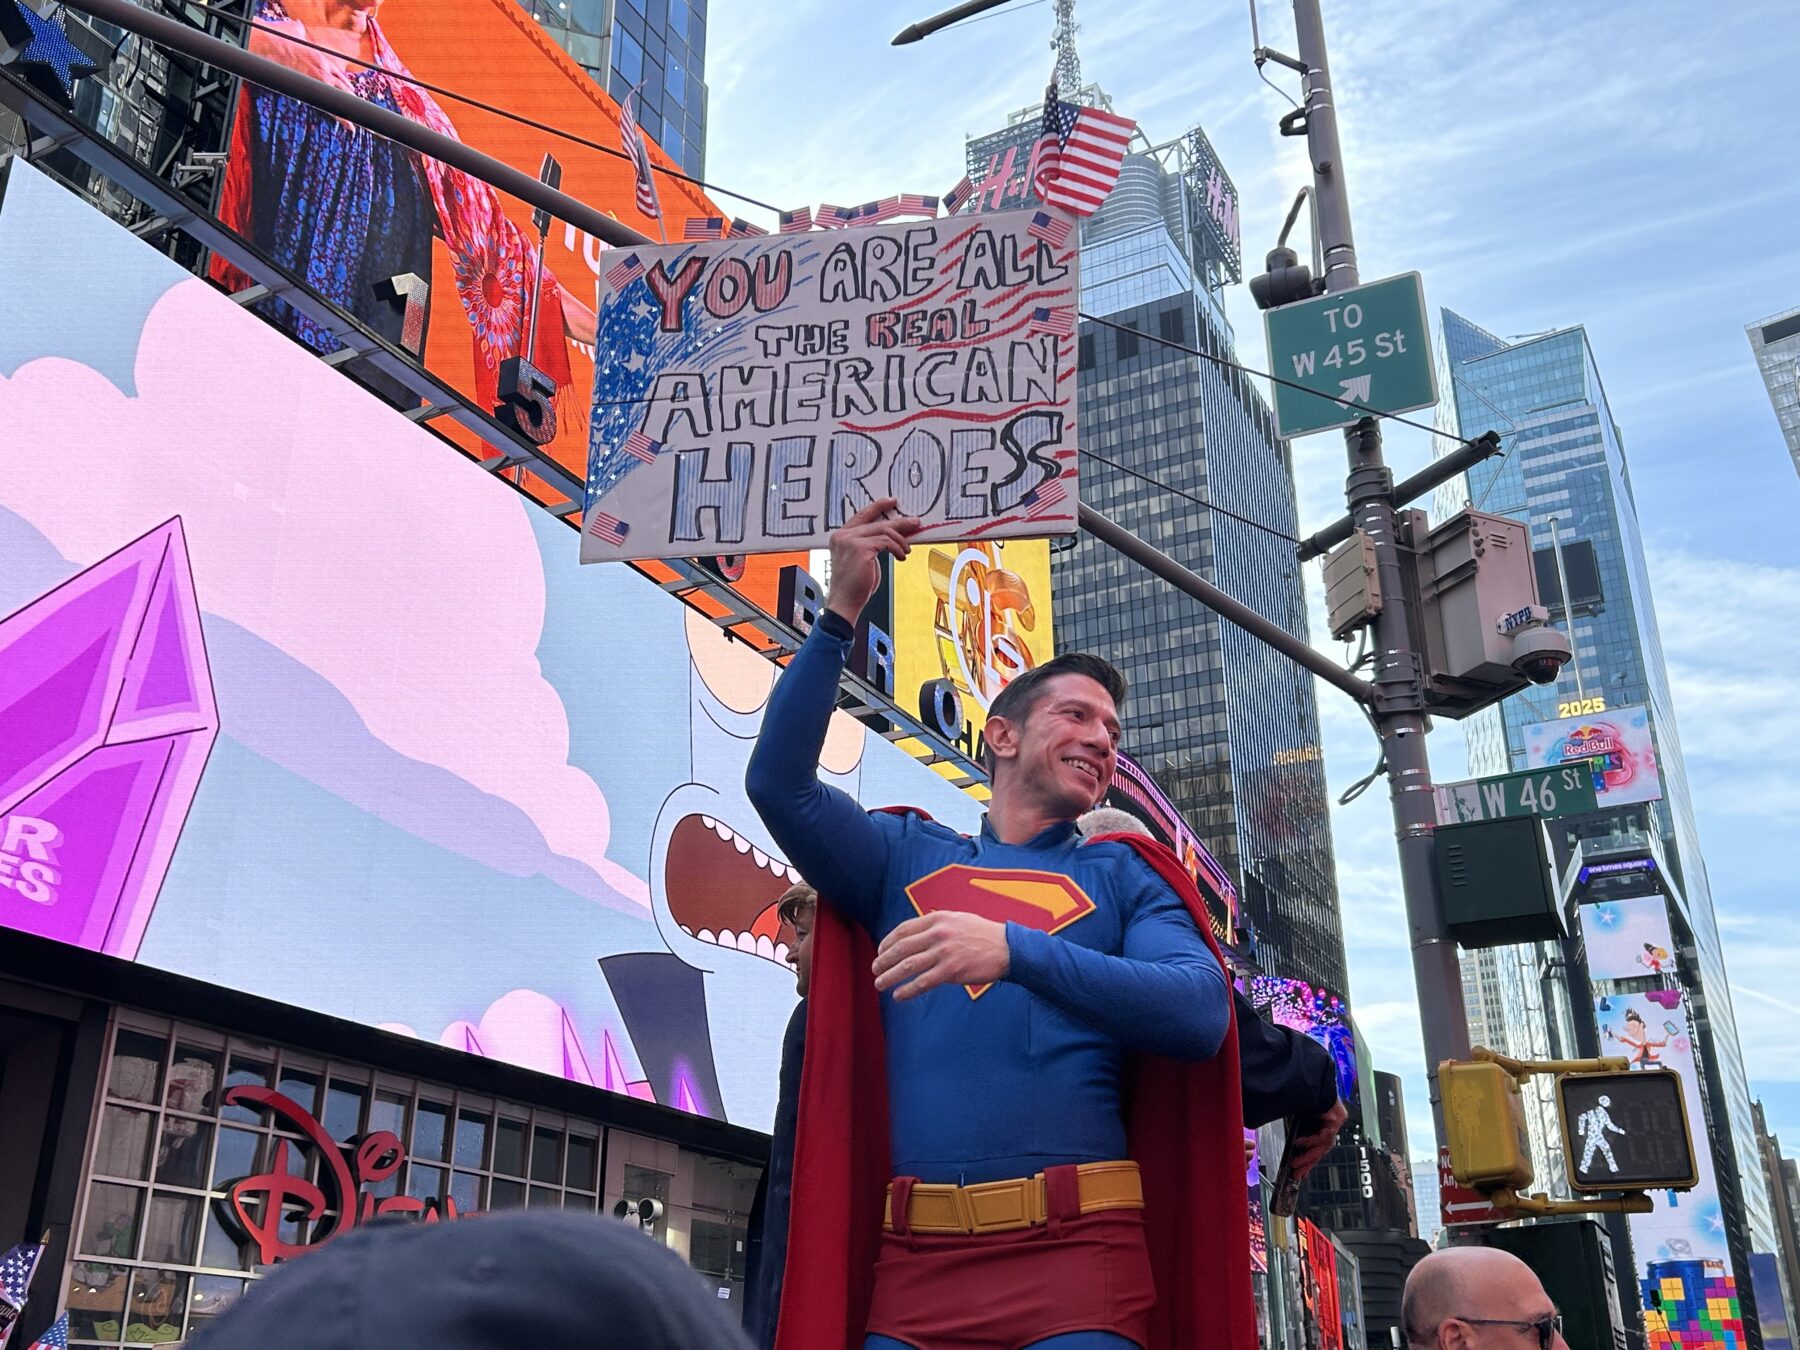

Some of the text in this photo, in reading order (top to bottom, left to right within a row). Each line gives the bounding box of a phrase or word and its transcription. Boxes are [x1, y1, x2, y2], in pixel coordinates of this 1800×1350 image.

[645, 227, 1069, 334] YOU ARE ALL
[754, 299, 990, 358] THE REAL
[1323, 304, 1363, 333] TO
[1292, 329, 1407, 378] W 45 St
[640, 335, 1060, 444] AMERICAN
[668, 410, 1064, 544] HEROES
[1504, 606, 1531, 631] NYPD
[1559, 697, 1606, 719] 2025
[1563, 736, 1614, 757] Red Bull
[1483, 768, 1583, 819] W 46 St
[1588, 859, 1648, 874] one times square
[1359, 1146, 1374, 1199] 1500
